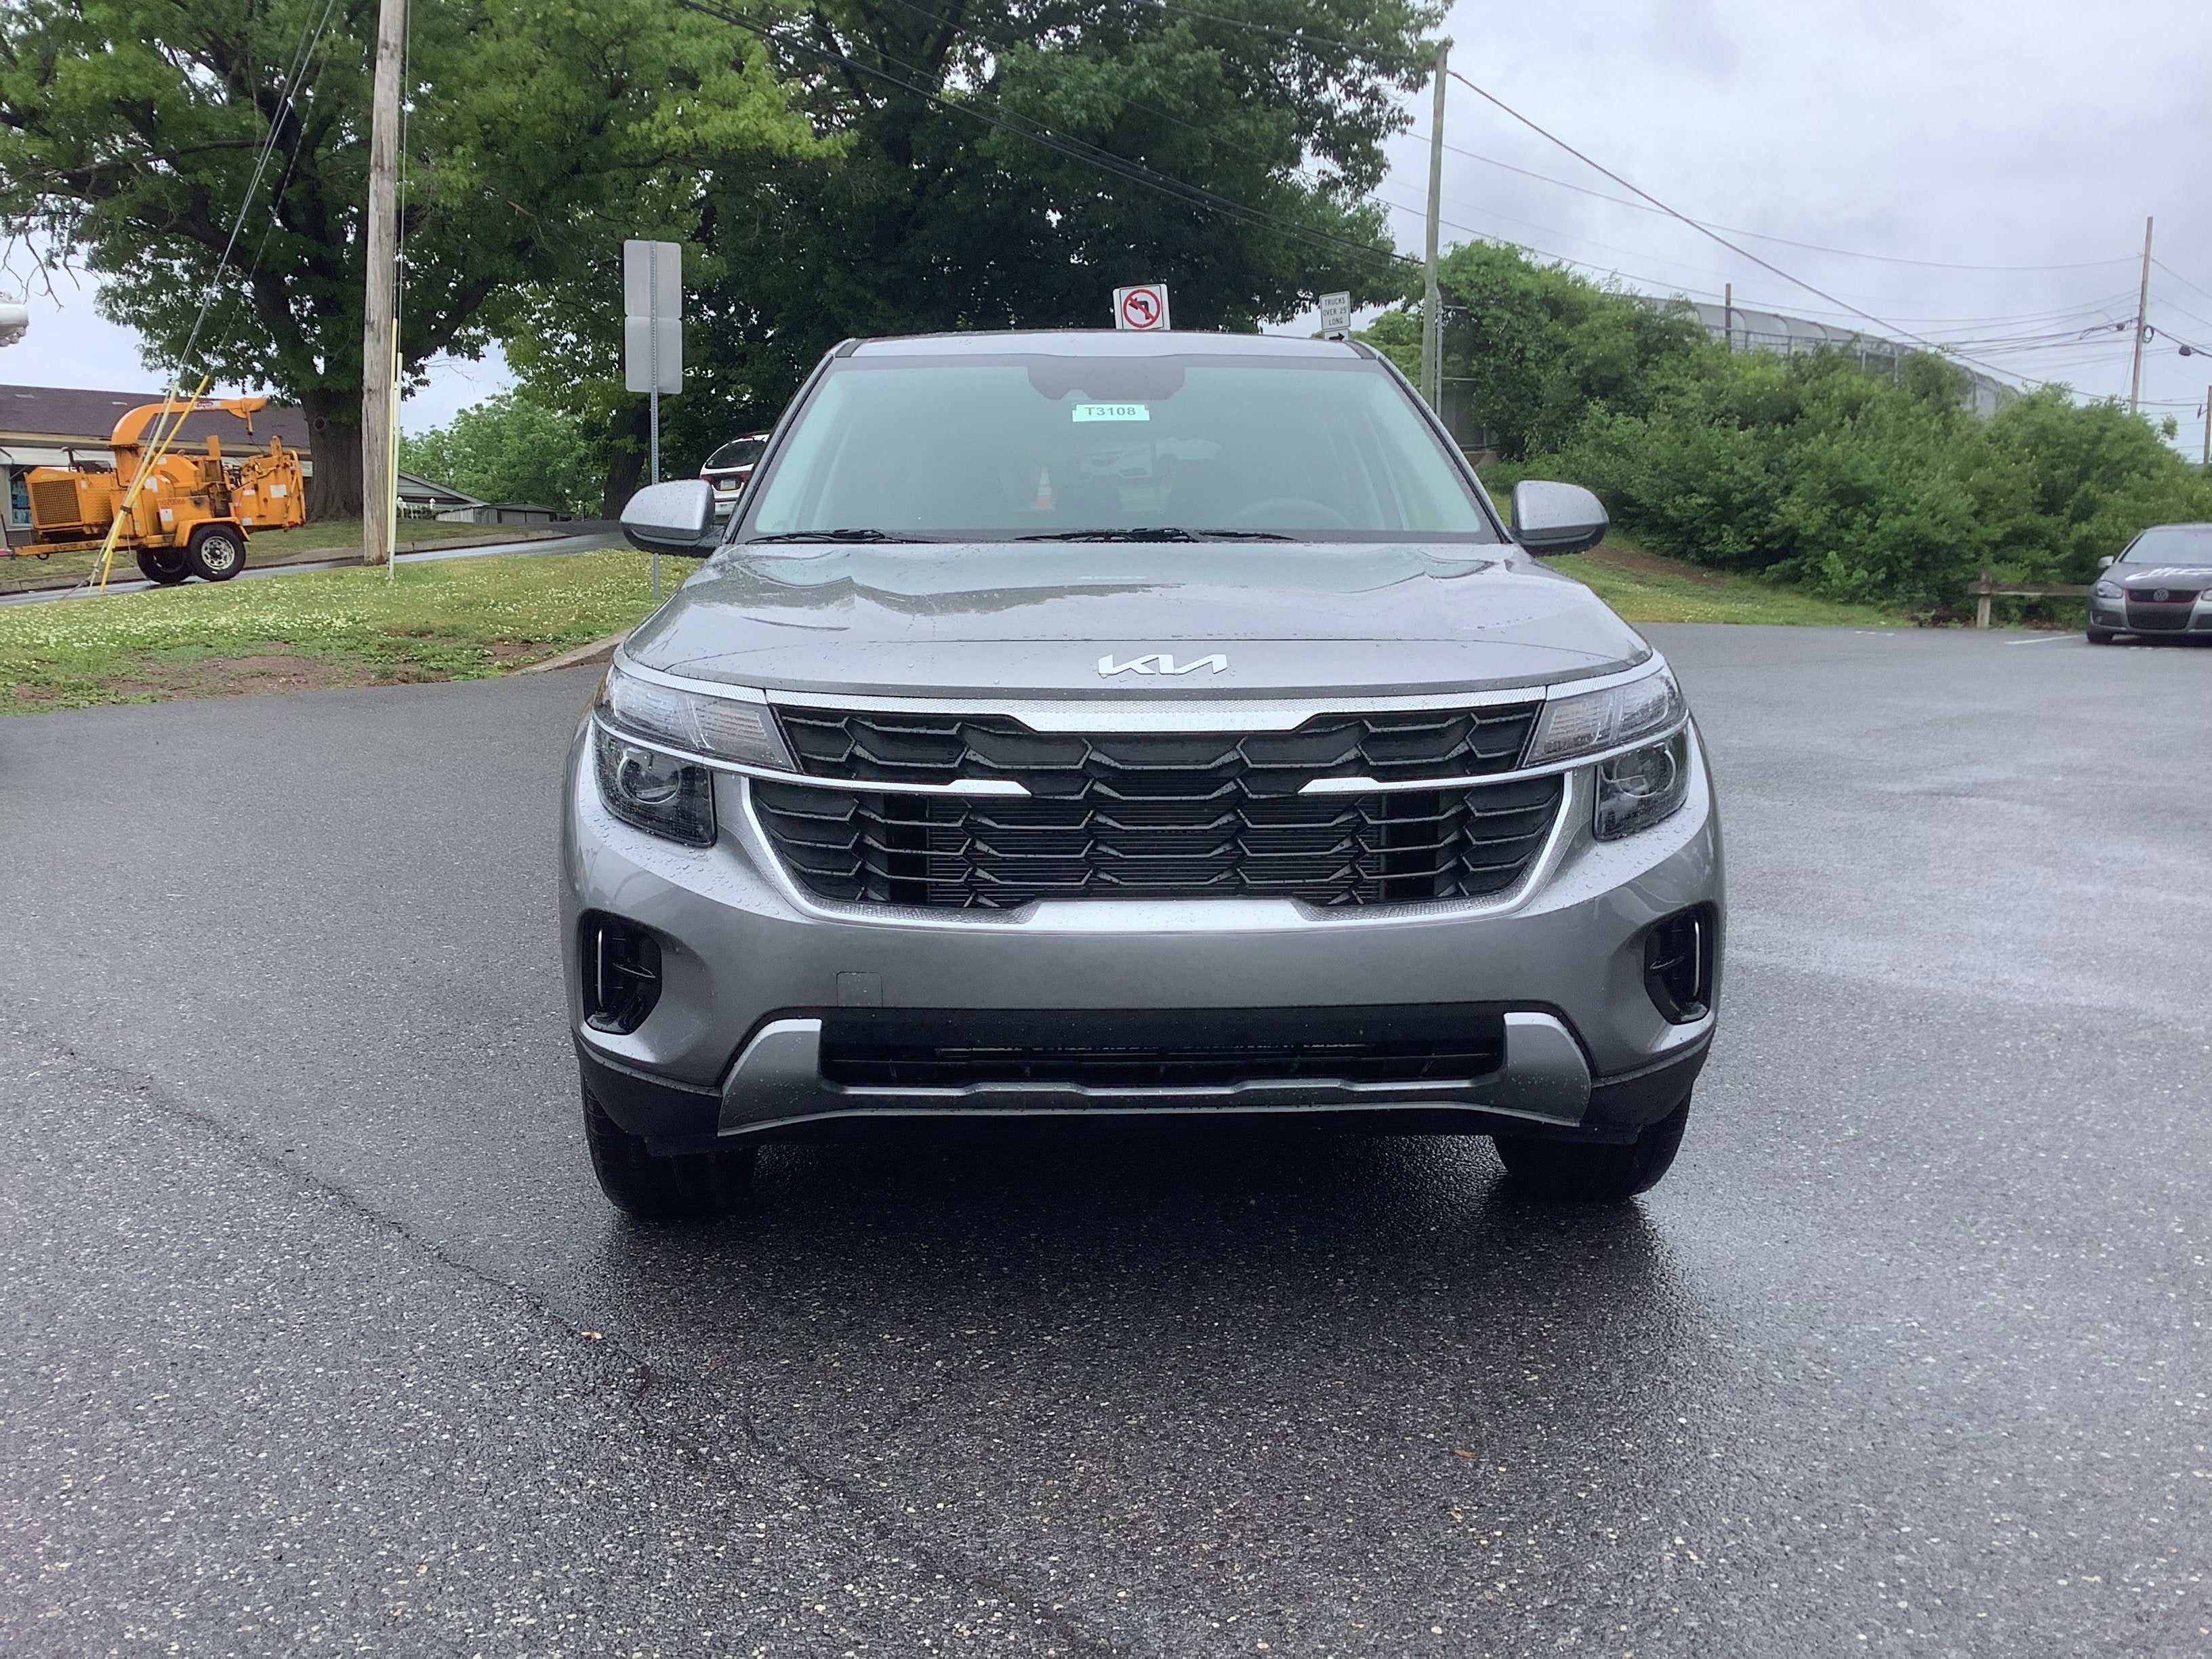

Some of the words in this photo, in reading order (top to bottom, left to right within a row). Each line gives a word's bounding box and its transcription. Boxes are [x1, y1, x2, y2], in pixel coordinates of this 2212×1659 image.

[1325, 298, 1345, 306] TRUCKS
[1322, 308, 1336, 316] OVER
[1329, 317, 1343, 325] LONG
[1084, 407, 1136, 416] T3108
[1098, 654, 1228, 675] KIA
